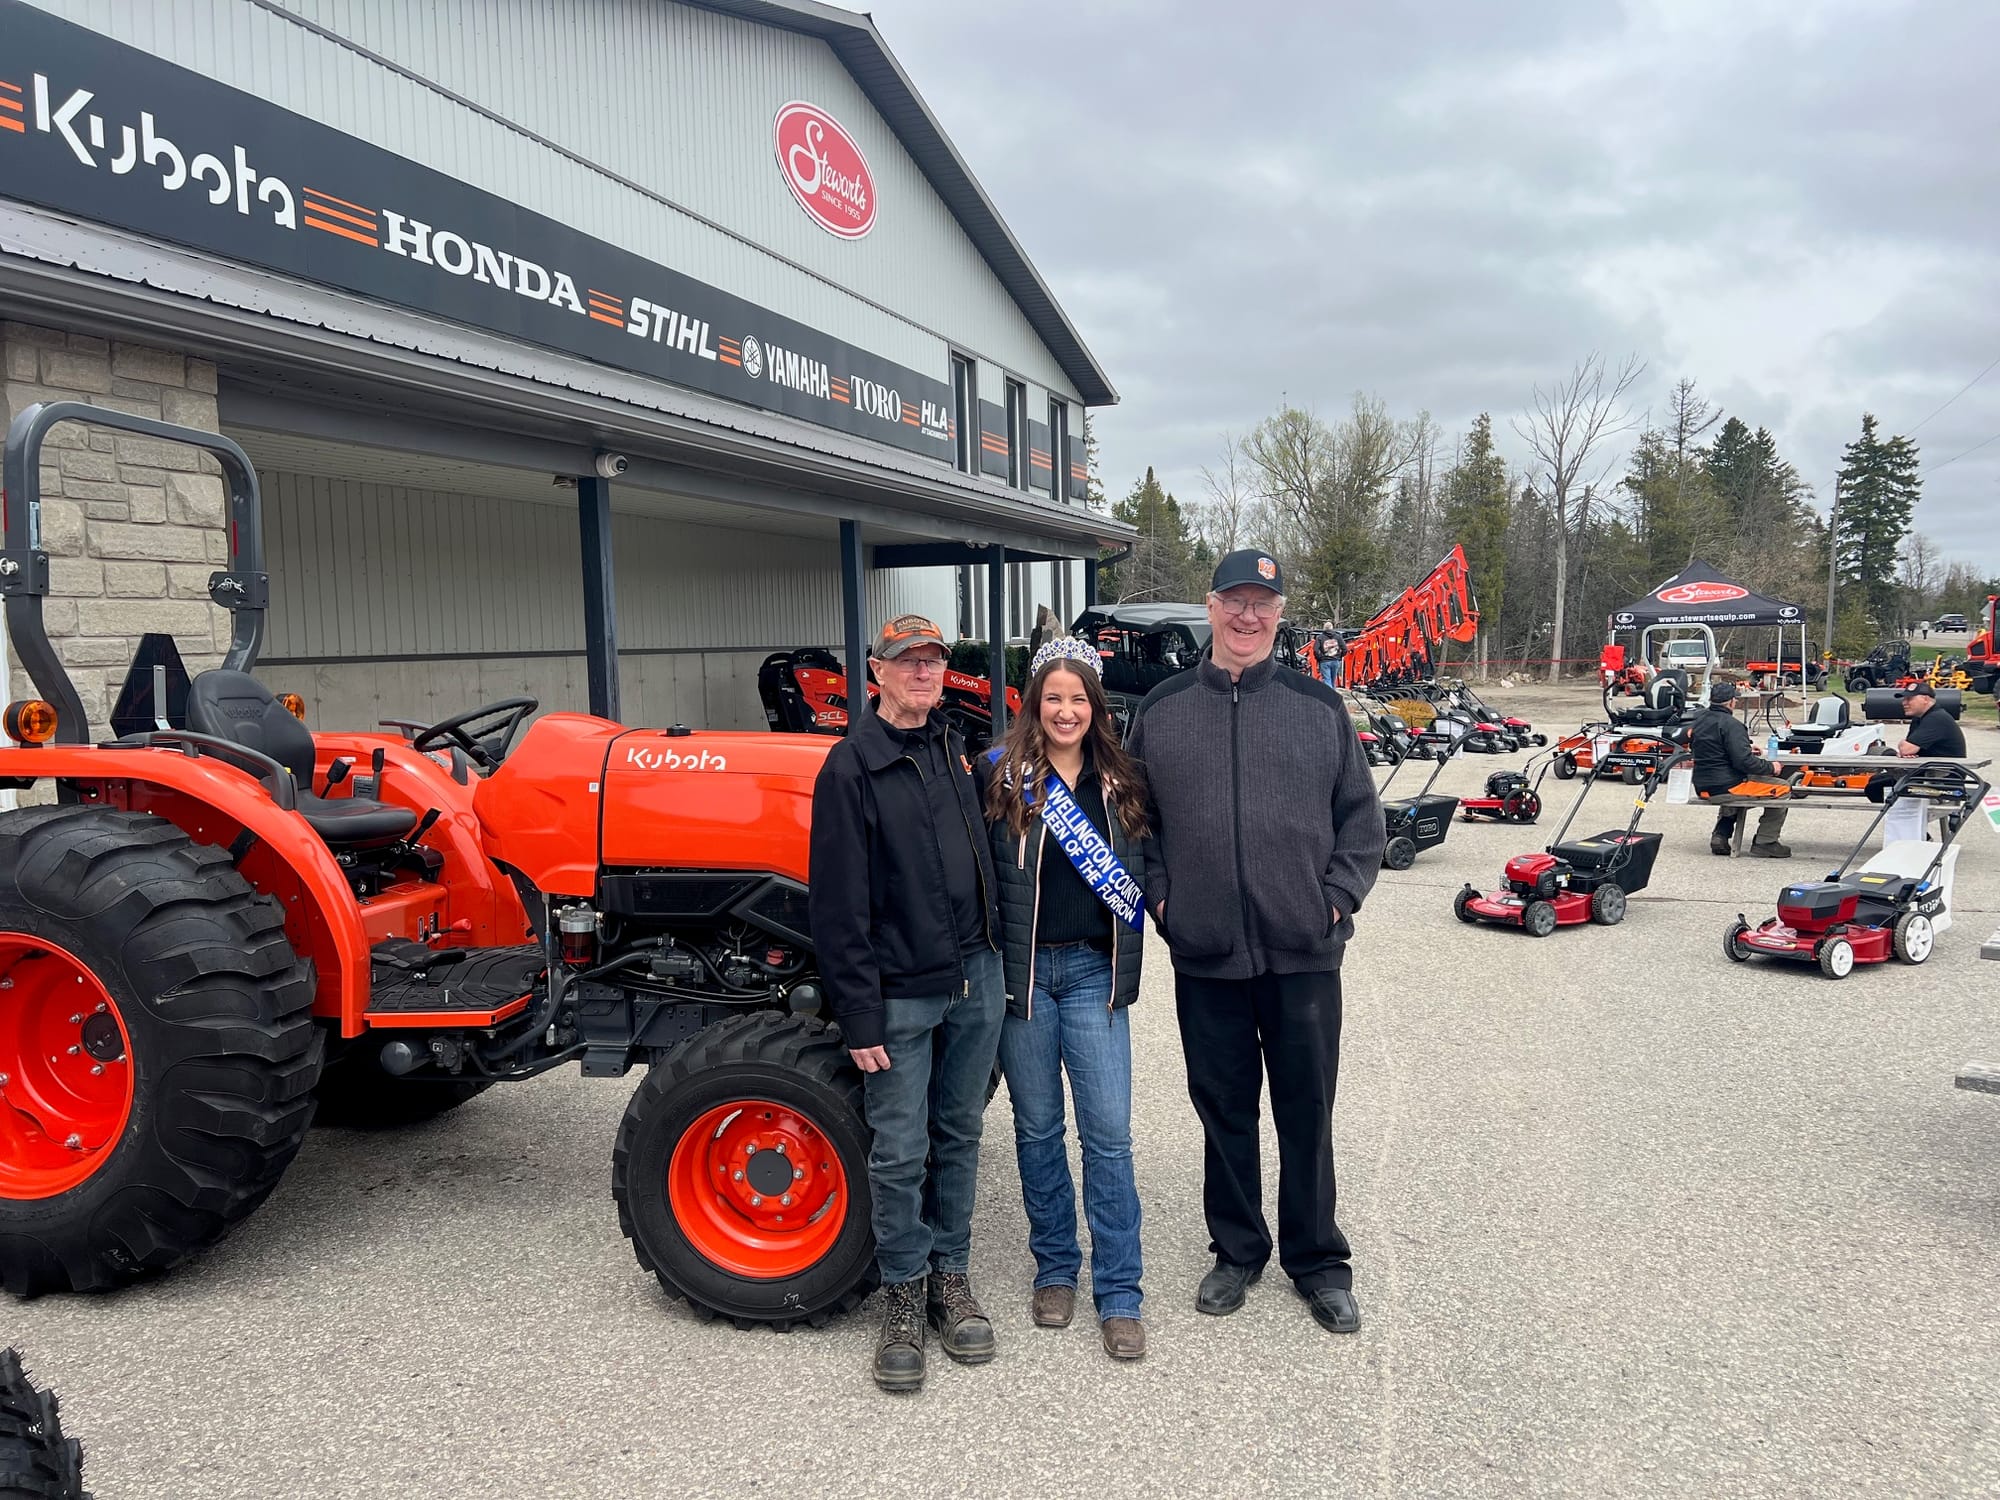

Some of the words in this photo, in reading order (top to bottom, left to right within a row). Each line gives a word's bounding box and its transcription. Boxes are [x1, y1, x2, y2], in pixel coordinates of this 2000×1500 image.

[34, 73, 296, 230] Kubota
[789, 120, 866, 210] Stewart's
[822, 190, 842, 210] SINCE
[844, 204, 861, 221] 1955
[382, 209, 586, 315] HONDA
[627, 297, 717, 361] STIHL
[765, 342, 831, 400] YAMAHA
[850, 374, 901, 423] TORO
[921, 399, 948, 431] HLA
[1658, 613, 1756, 623] www.stewartsequip.com
[950, 675, 979, 689] Kubota
[818, 711, 844, 721] SCL
[626, 747, 727, 771] Kubota
[1047, 783, 1115, 874] WELLINGTON
[1108, 866, 1143, 909] COUNTY
[1419, 822, 1437, 833] TORO
[1065, 840, 1085, 858] OF
[1078, 857, 1103, 886] THE
[1096, 882, 1137, 924] FURROW
